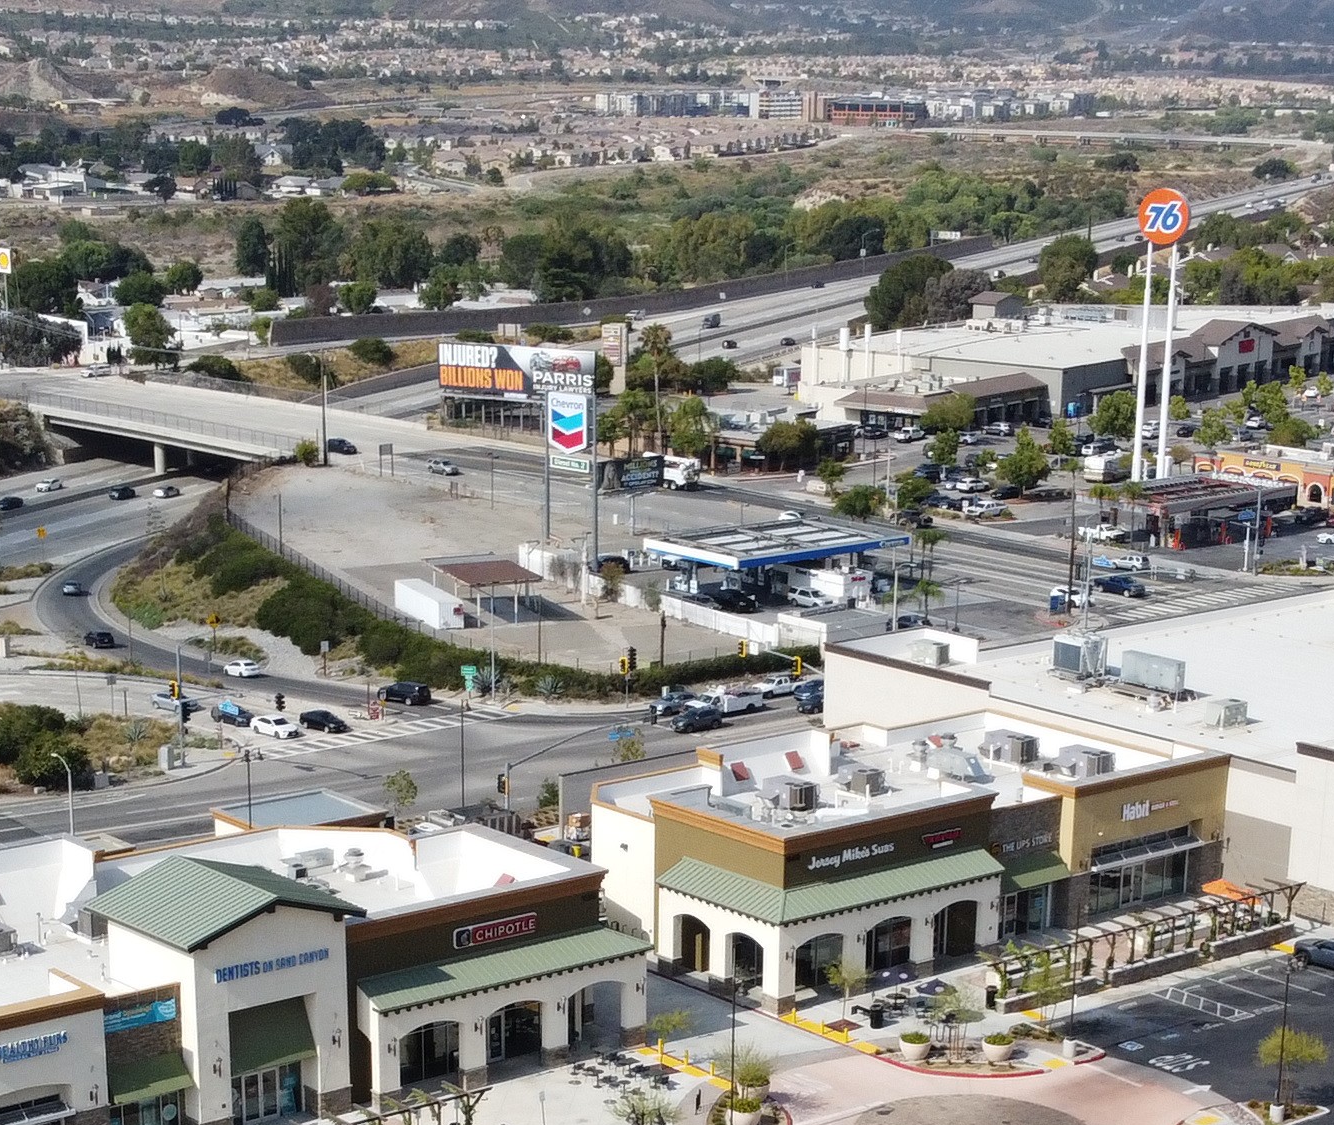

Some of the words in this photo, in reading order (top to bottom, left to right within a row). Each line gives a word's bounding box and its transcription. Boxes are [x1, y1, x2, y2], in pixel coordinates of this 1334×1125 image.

[1144, 201, 1182, 234] 76
[438, 343, 498, 368] INJURED?
[440, 366, 493, 389] BILLIONS
[494, 368, 524, 391] WON
[532, 371, 593, 387] PARRIS
[558, 385, 592, 394] LAWYERS
[551, 397, 584, 411] Chevron
[1122, 799, 1150, 822] Habit
[1002, 842, 1015, 853] THE
[1017, 838, 1030, 850] UPS
[1031, 833, 1053, 847] STORE
[808, 855, 841, 871] Jersey
[842, 846, 870, 863] Mike's
[475, 918, 536, 942] CHIPOTLE
[215, 960, 261, 984] DENTISTS
[275, 954, 297, 971] SAND
[298, 947, 330, 967] CANYON
